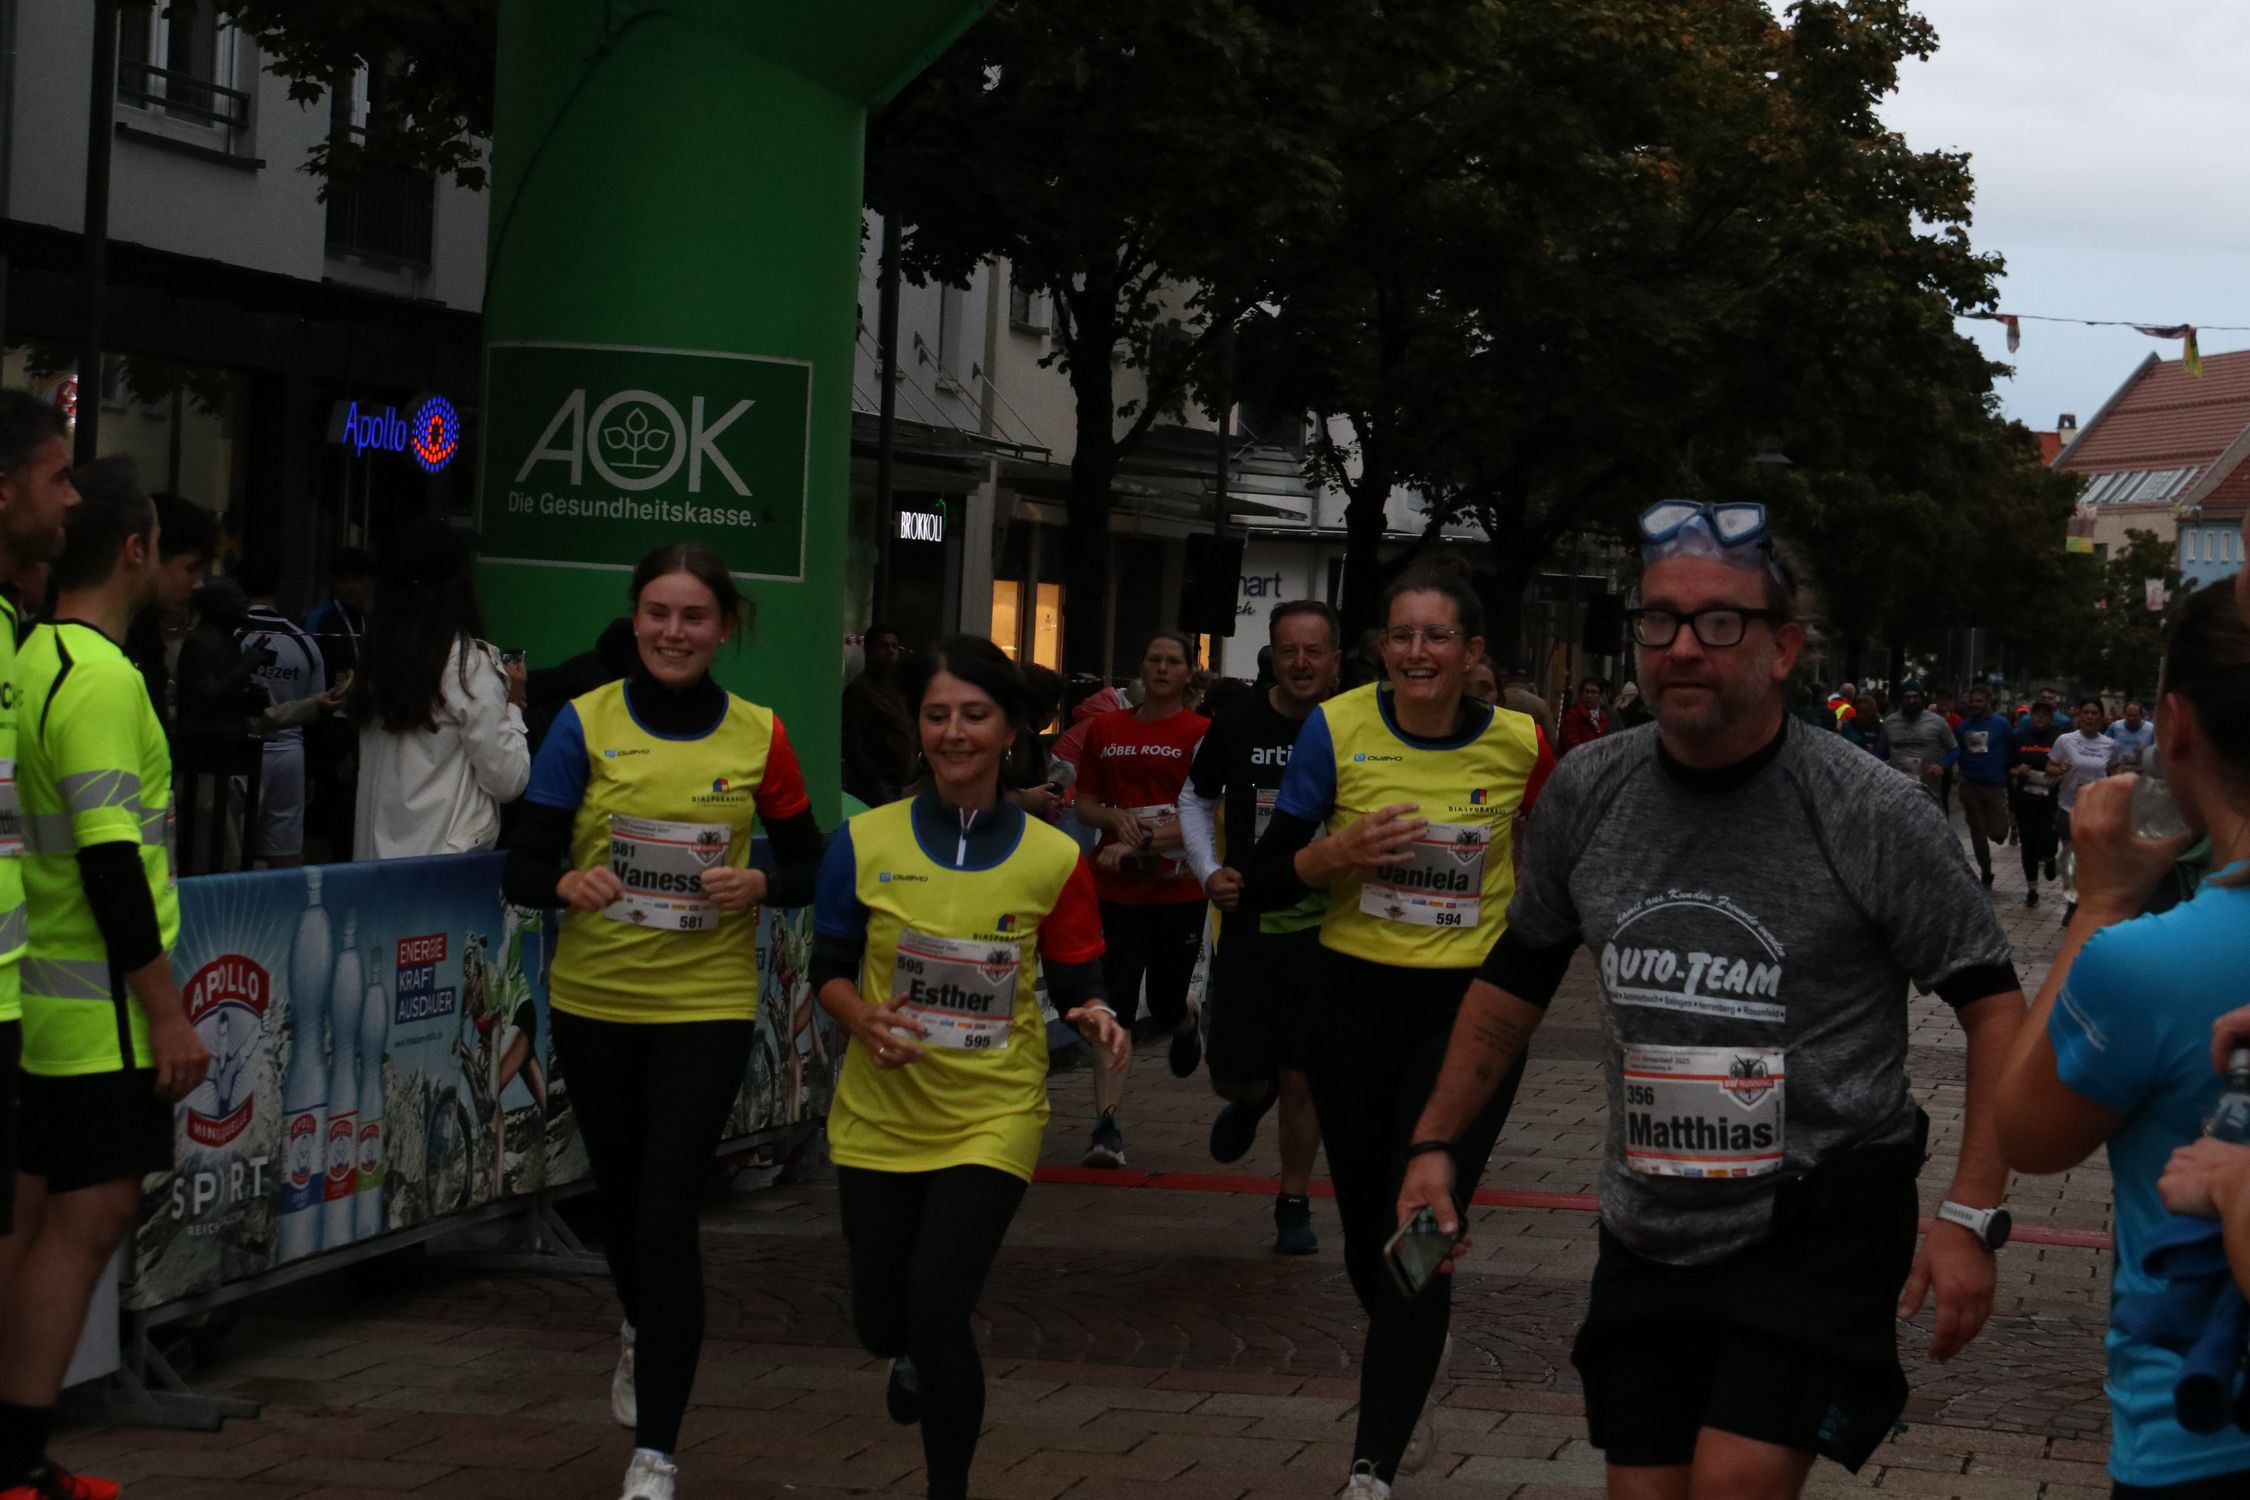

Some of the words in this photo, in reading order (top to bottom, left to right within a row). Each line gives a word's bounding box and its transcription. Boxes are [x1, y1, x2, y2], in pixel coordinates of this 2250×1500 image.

[342, 400, 407, 458] Apollo
[514, 388, 757, 497] AOK
[508, 491, 534, 512] Die
[539, 492, 758, 528] Gesundheitskasse.
[901, 510, 942, 542] BROKKOLI
[1141, 745, 1182, 759] ROGG
[1250, 744, 1294, 766] arti
[612, 841, 636, 858] 581
[613, 860, 701, 893] Vaness
[679, 915, 704, 929] 581
[1436, 912, 1462, 926] 594
[896, 956, 924, 975] 595
[1601, 941, 1783, 998] AUTO-TEAM
[190, 965, 260, 1015] APOLLO
[909, 978, 996, 1013] Esther
[965, 1034, 991, 1048] 595
[1626, 1085, 1655, 1106] 356
[1628, 1111, 1773, 1151] Matthias
